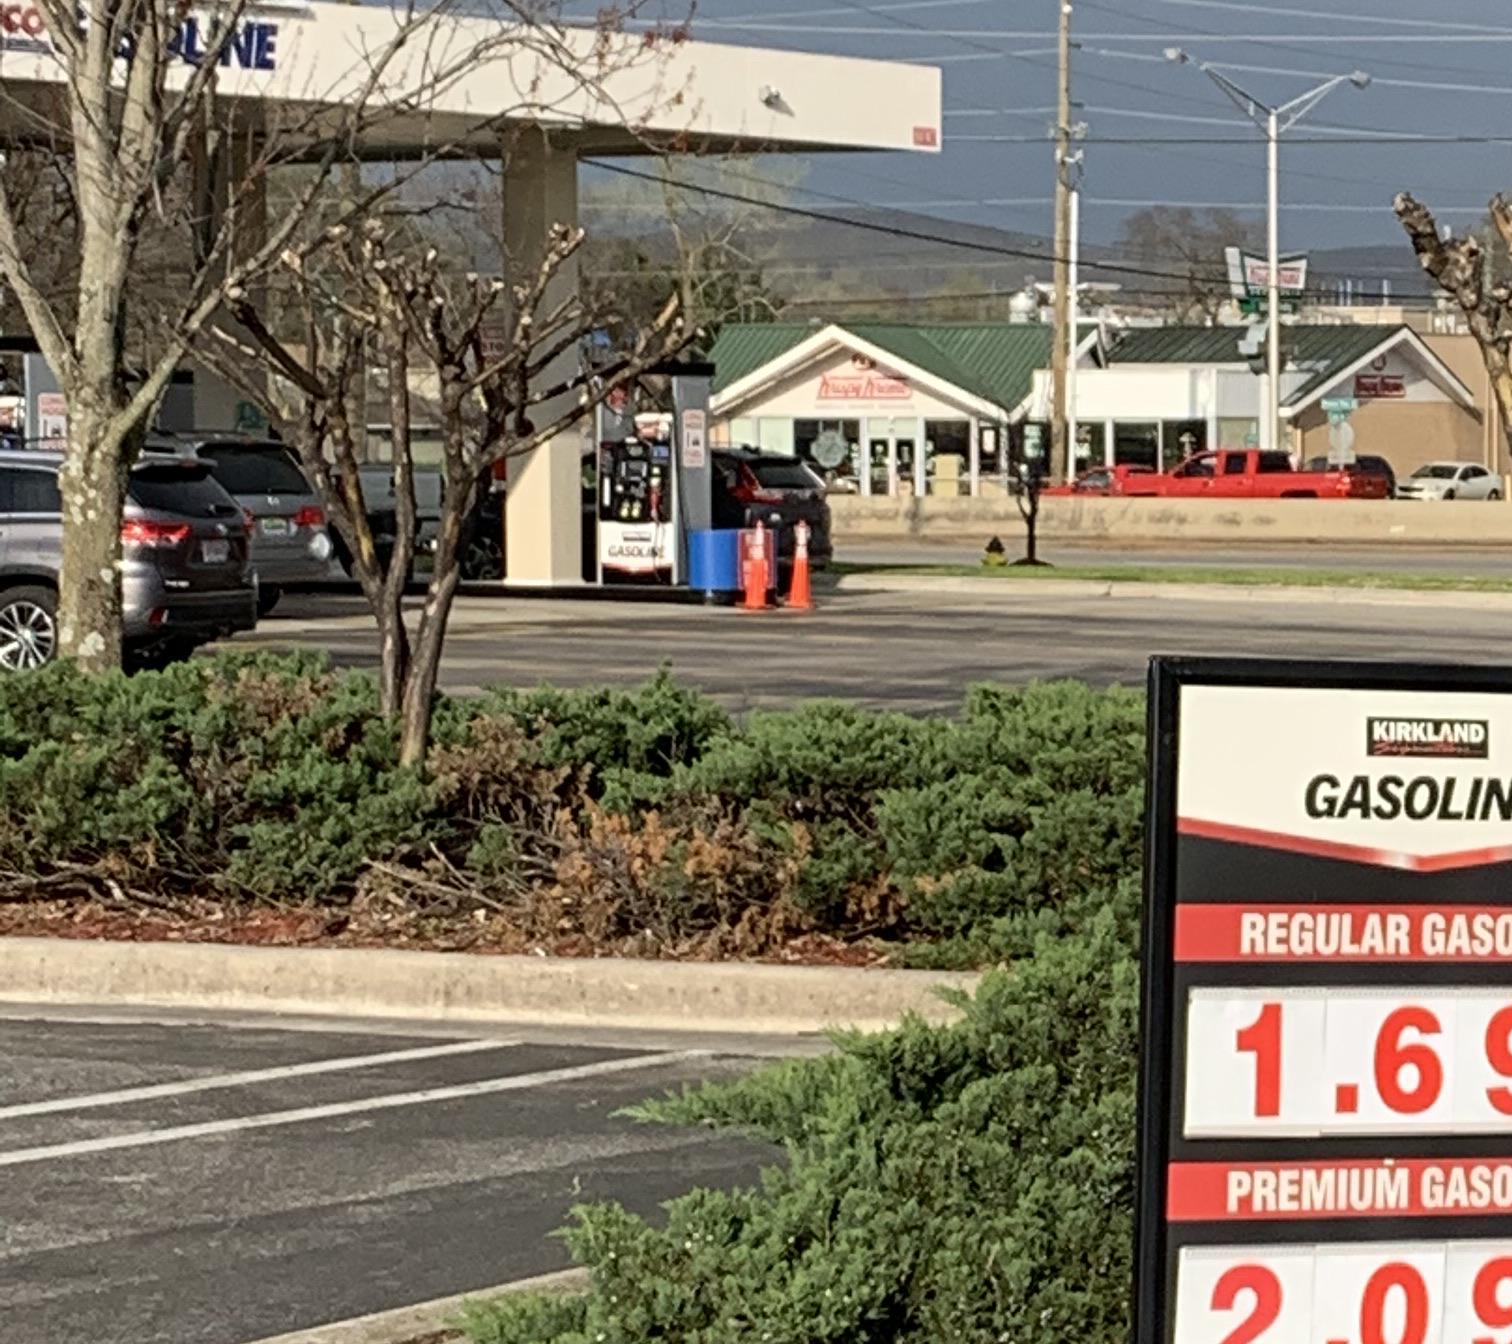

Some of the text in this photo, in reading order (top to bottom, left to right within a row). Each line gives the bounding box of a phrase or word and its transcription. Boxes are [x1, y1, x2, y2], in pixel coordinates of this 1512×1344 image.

[1372, 720, 1485, 744] KIRKLAND
[1239, 912, 1410, 956] REGULAR
[1226, 1167, 1409, 1213] PREMIUM
